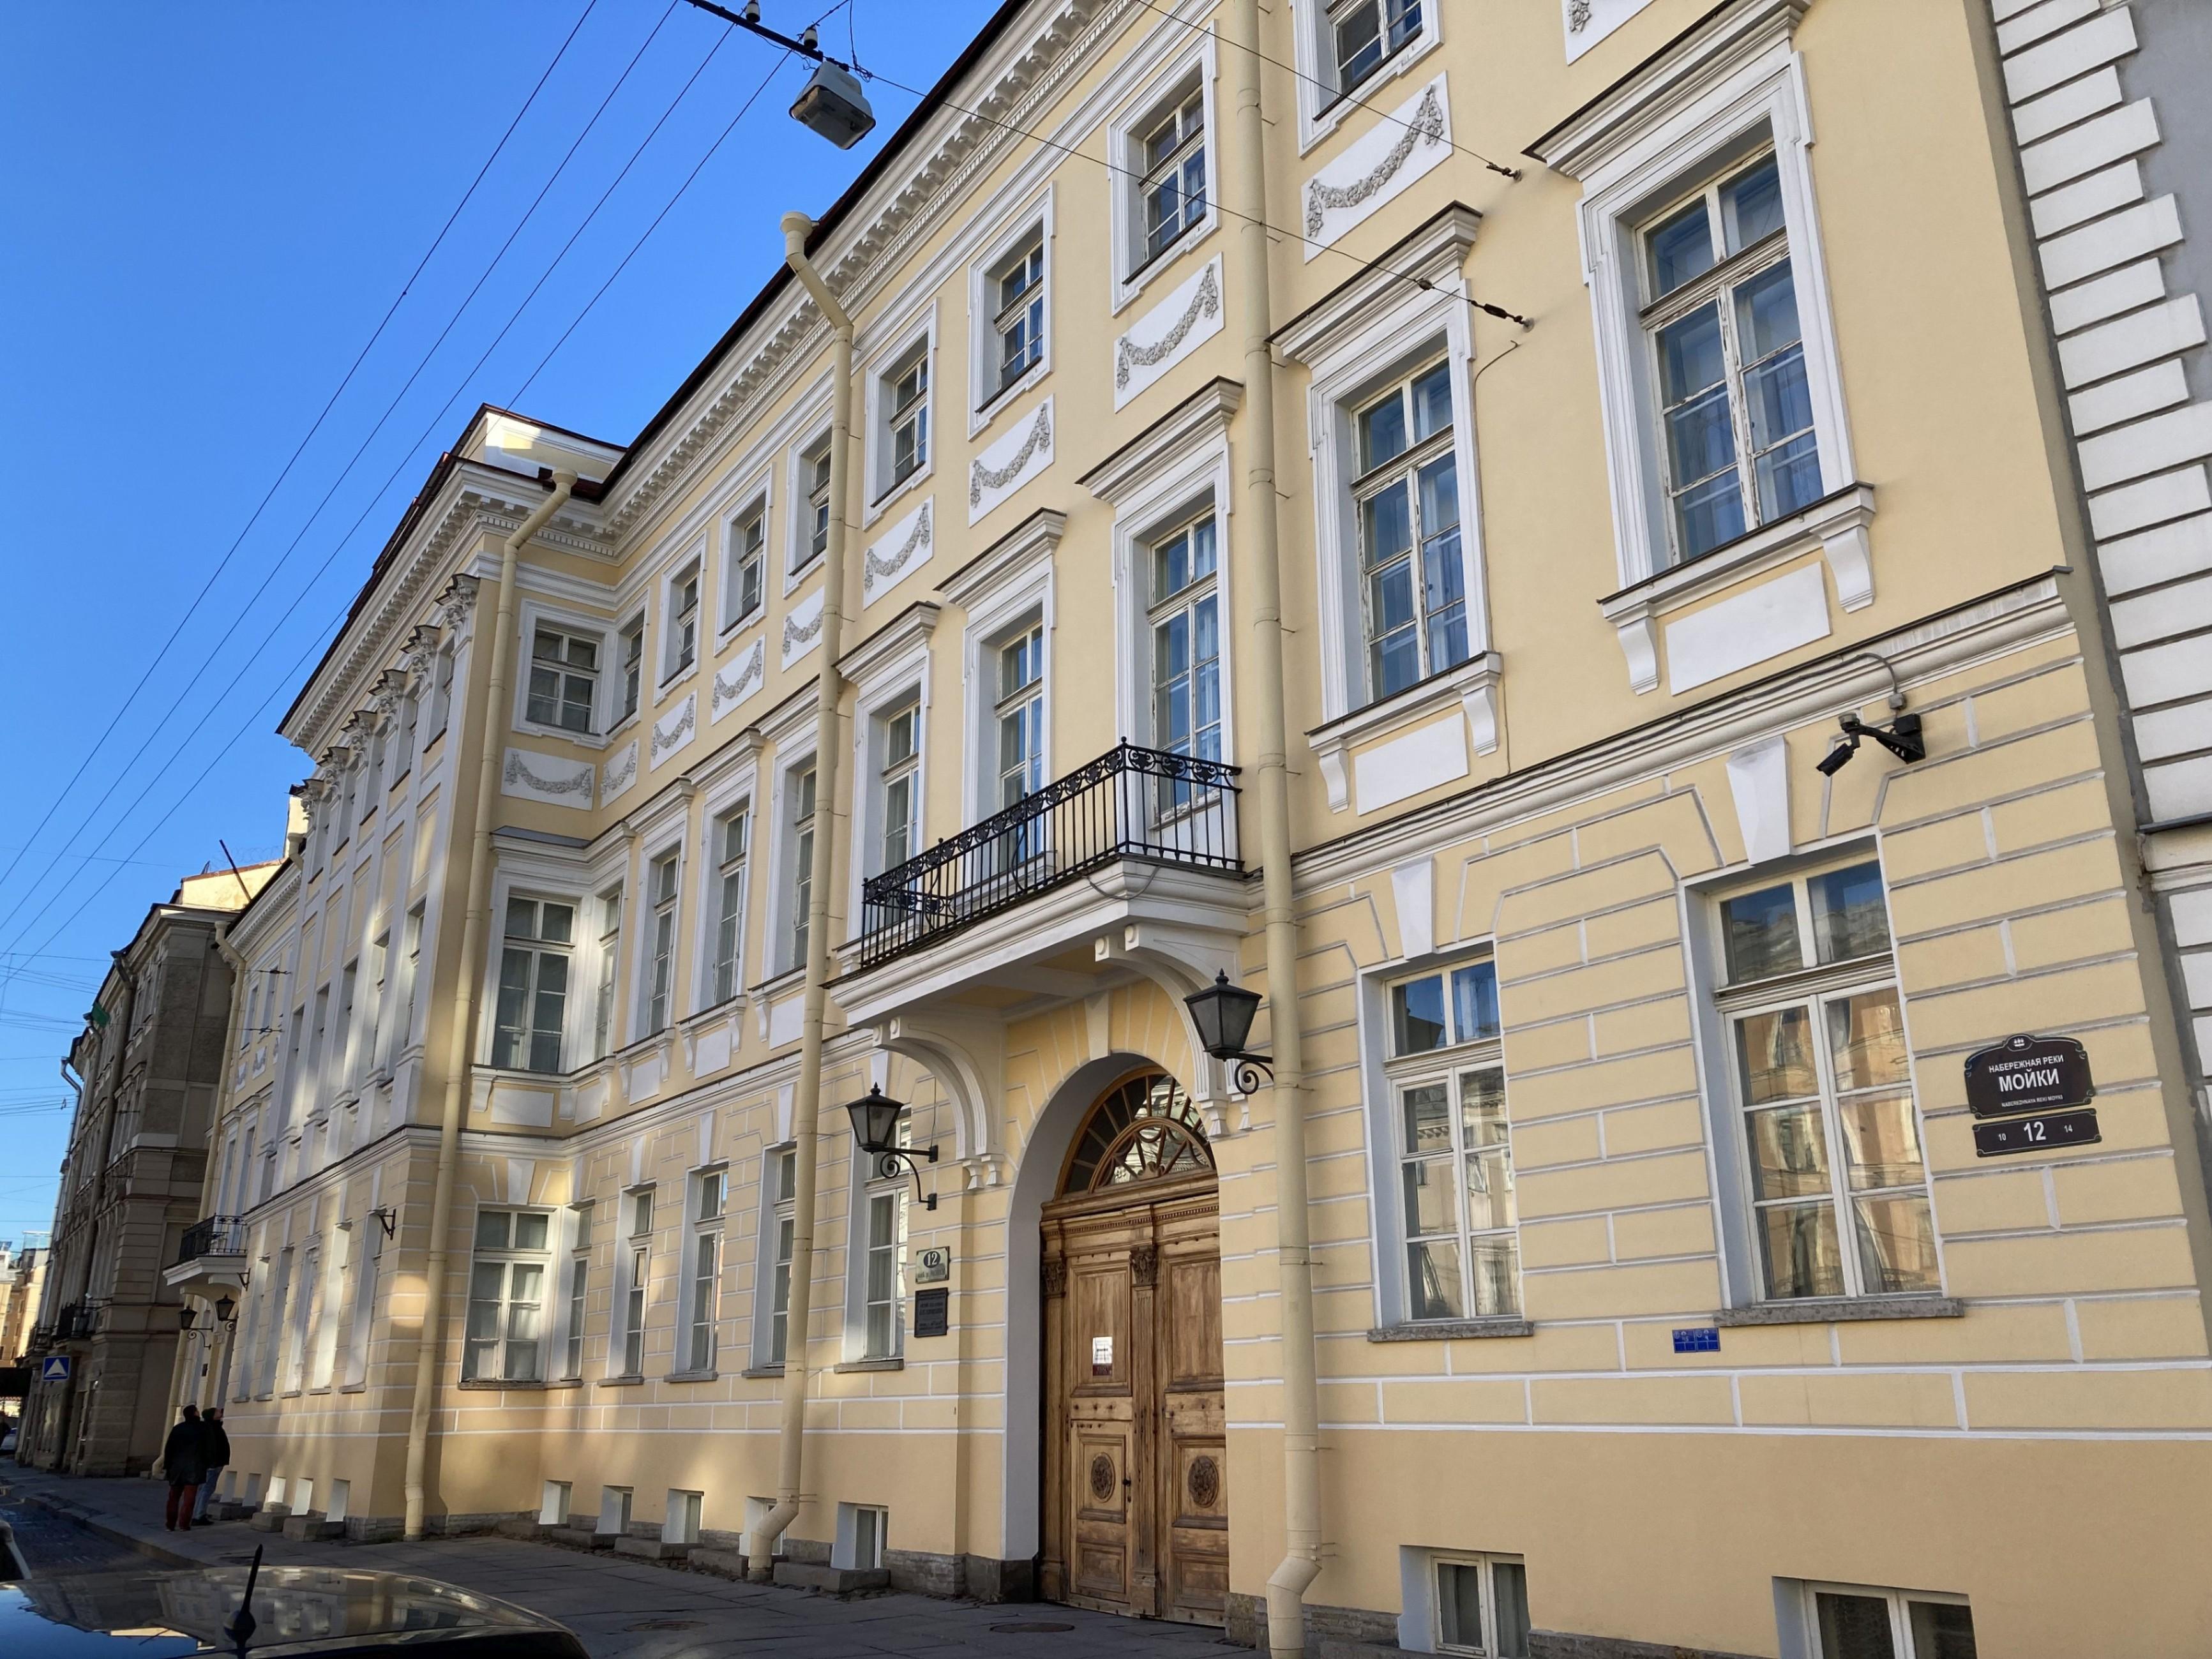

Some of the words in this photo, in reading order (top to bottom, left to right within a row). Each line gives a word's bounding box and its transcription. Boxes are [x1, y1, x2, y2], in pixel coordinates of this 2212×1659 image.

[1989, 1058, 2042, 1073] НАБЕРЕЖНАЯ
[2043, 1055, 2064, 1065] РЕКИ
[1999, 1068, 2059, 1092] МОЙКИ
[1998, 1133, 2006, 1141] 10
[2023, 1121, 2047, 1141] 12
[2064, 1124, 2073, 1133] 14
[927, 1252, 938, 1267] 12
